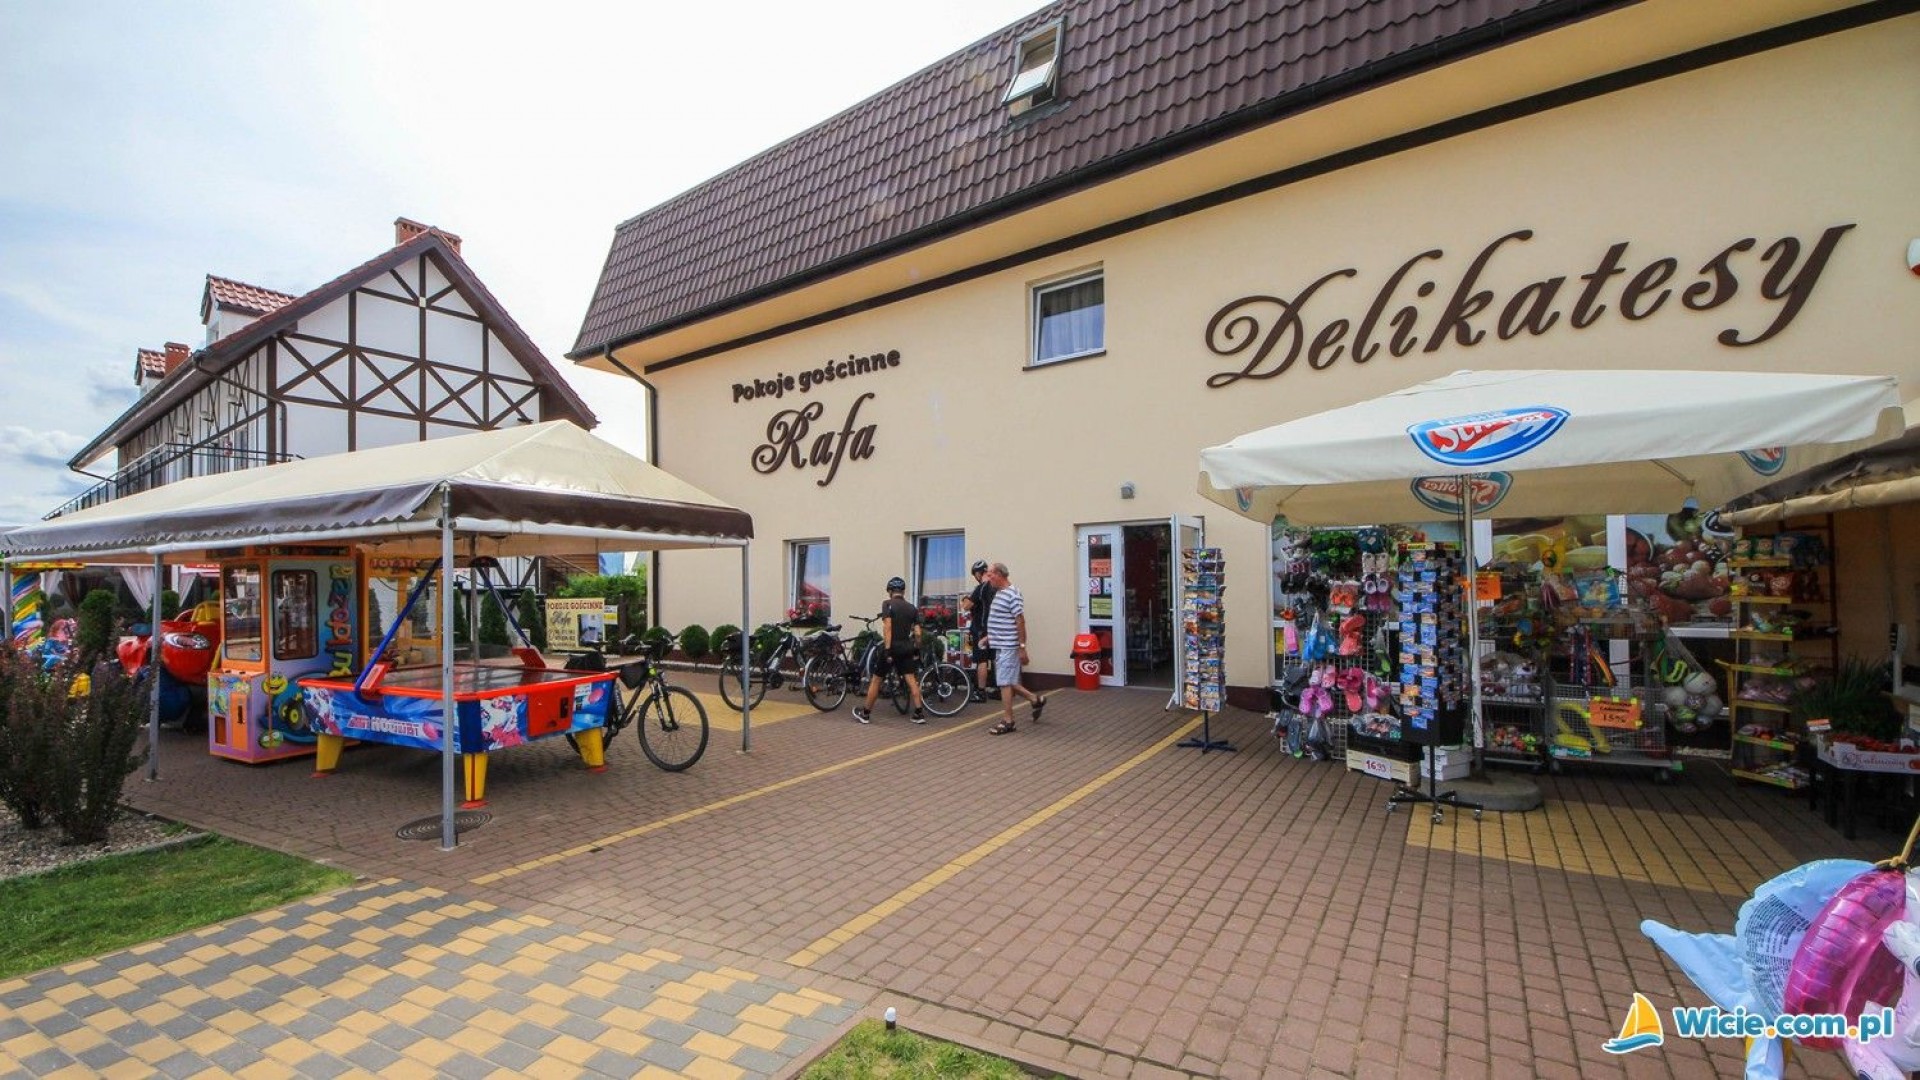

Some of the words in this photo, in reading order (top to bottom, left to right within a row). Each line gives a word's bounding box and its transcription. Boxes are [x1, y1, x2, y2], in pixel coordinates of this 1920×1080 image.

[1205, 223, 1857, 389] Delikatesy
[731, 373, 795, 403] Pokoje
[799, 350, 901, 393] gościnne
[751, 393, 878, 487] Rafa
